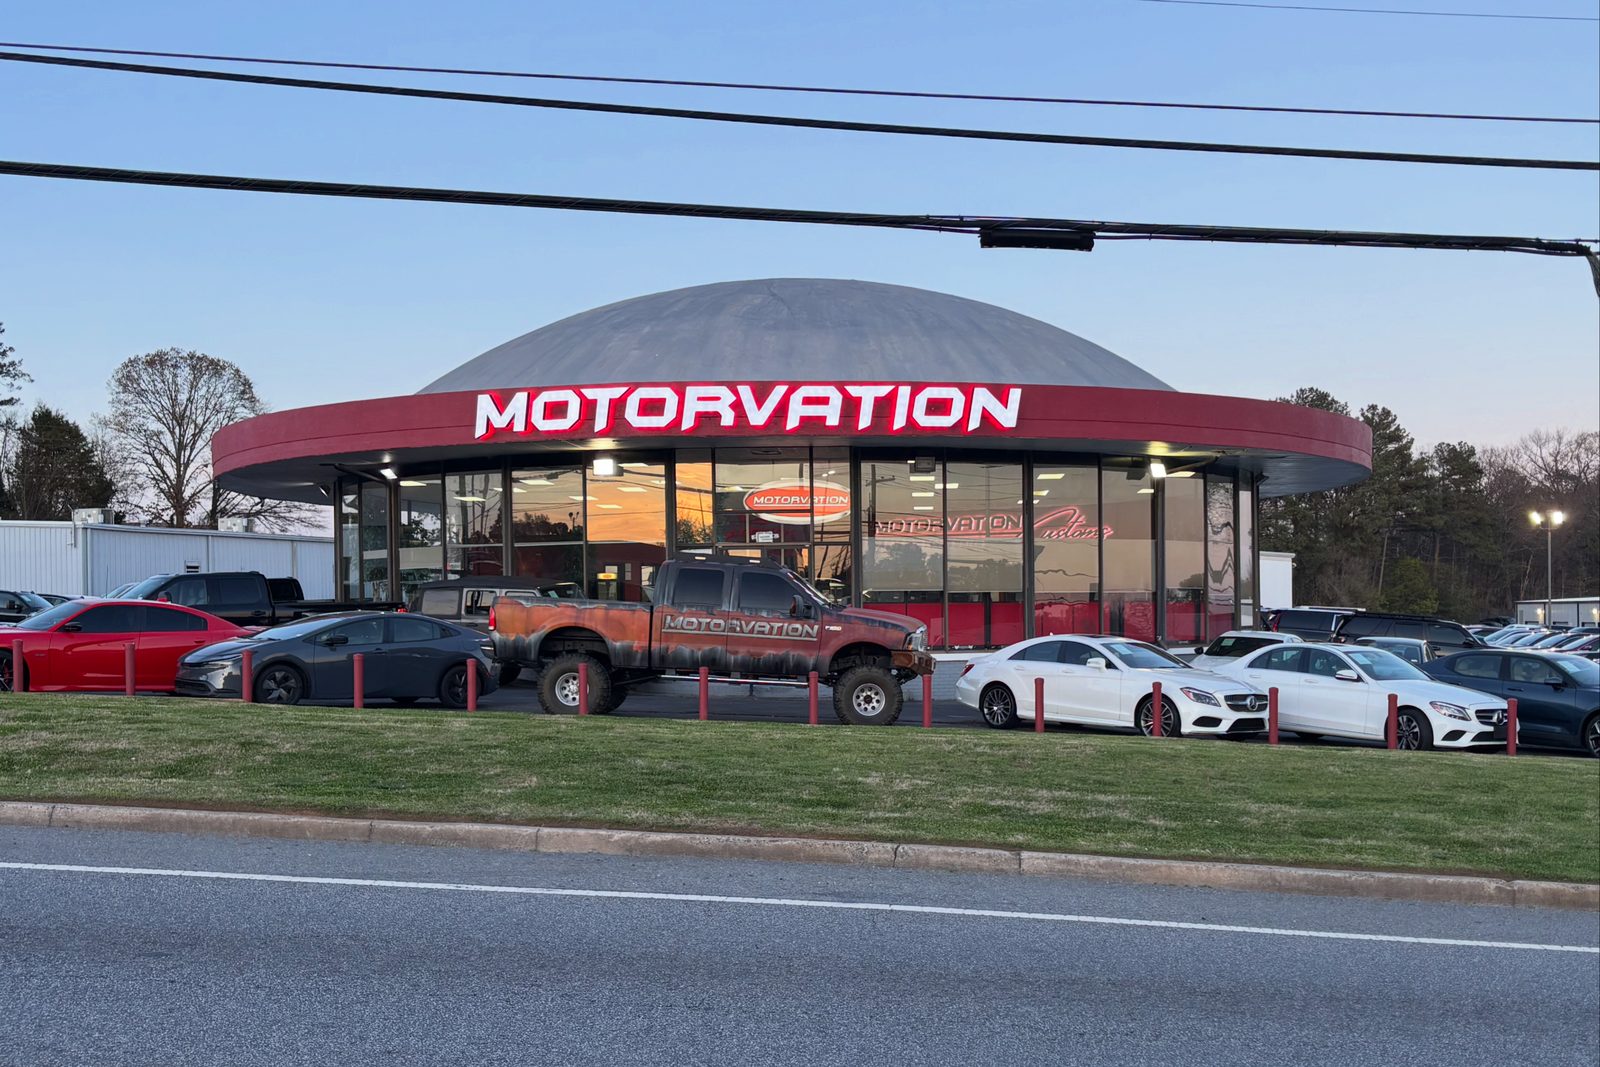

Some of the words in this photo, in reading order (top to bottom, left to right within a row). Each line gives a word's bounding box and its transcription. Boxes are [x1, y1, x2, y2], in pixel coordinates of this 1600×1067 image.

[475, 384, 1023, 439] MOTORVATION
[875, 513, 1023, 535] MOTORVATON
[664, 615, 820, 638] MOTORVATION
